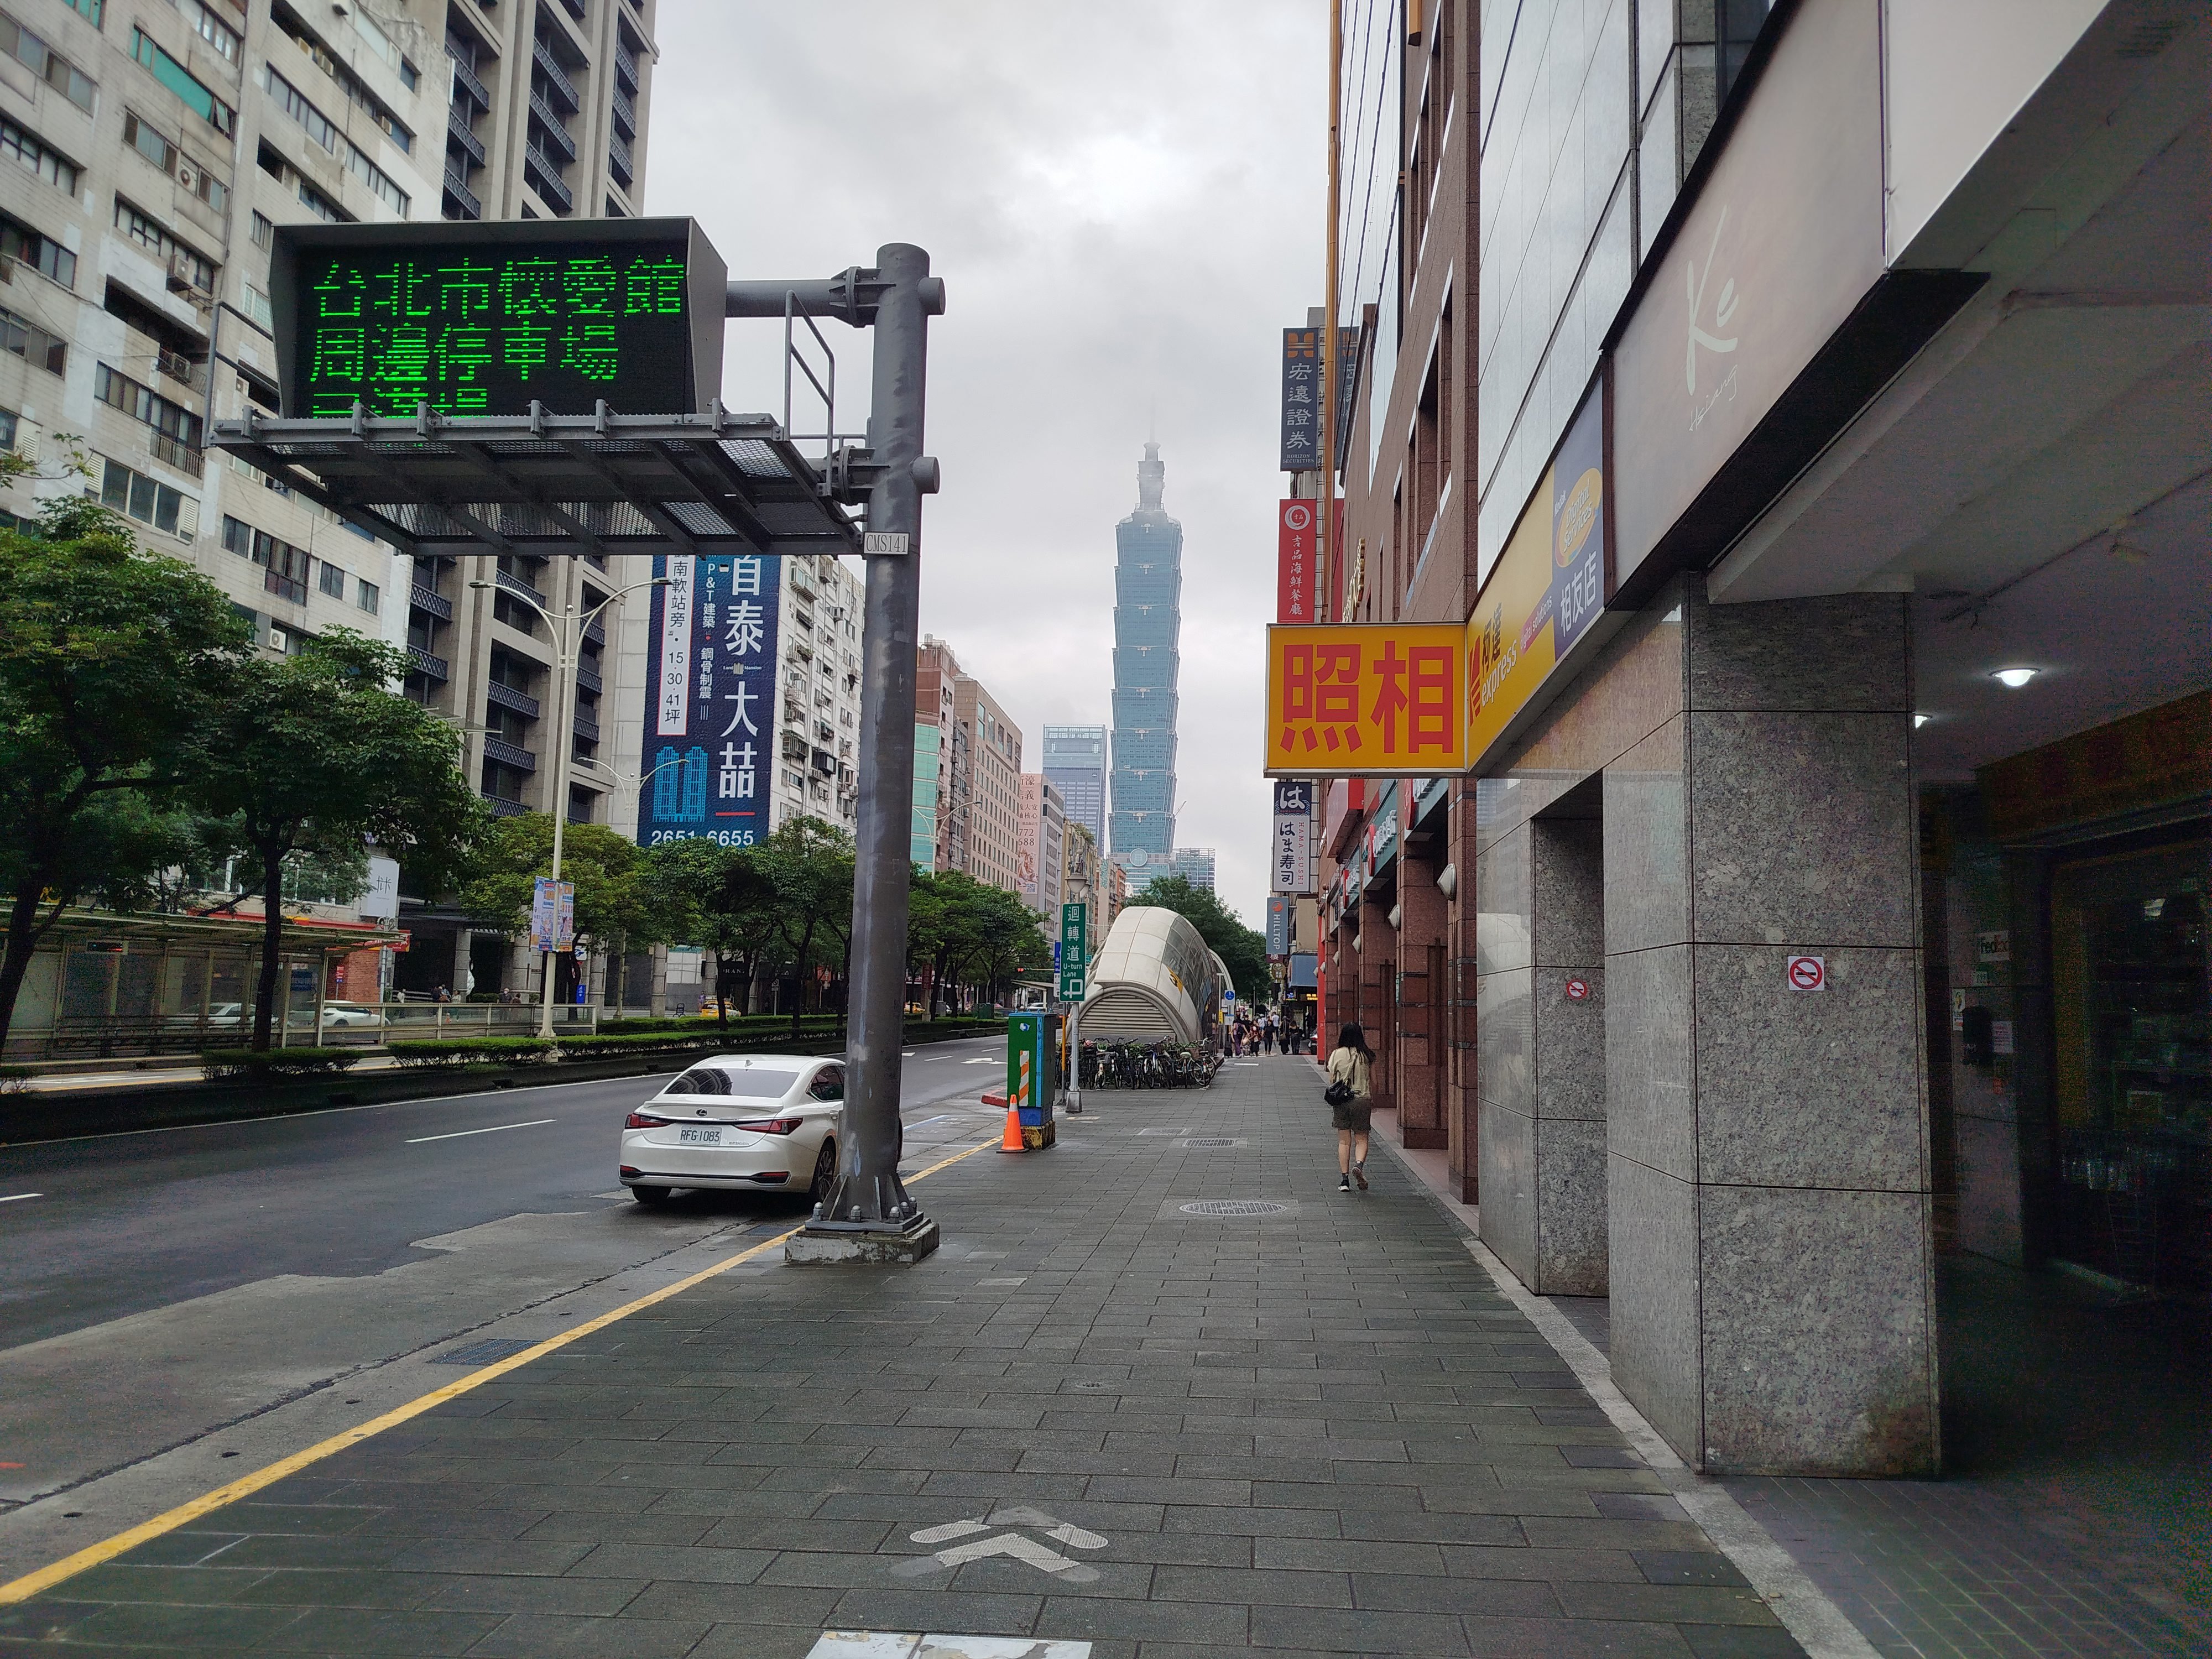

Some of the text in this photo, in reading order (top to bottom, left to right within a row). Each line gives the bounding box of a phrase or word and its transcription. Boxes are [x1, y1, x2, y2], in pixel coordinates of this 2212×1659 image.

[314, 254, 685, 318] 台北市懷愛館
[310, 321, 619, 382] 周邊停車場
[1286, 362, 1313, 450] 宏遠證券
[865, 535, 907, 553] CMS141
[1288, 534, 1304, 616] 吉品海鮮餐廳
[1520, 594, 1553, 650] digital solutions
[1560, 550, 1597, 638] 相友店
[1481, 601, 1503, 679] 柯達
[1280, 640, 1454, 754] 照相
[1481, 639, 1517, 707] express
[1280, 785, 1306, 810] は
[1279, 821, 1296, 885] はま寿司
[1066, 906, 1080, 961] 迴轉道
[680, 1129, 721, 1142] RFG-1083
